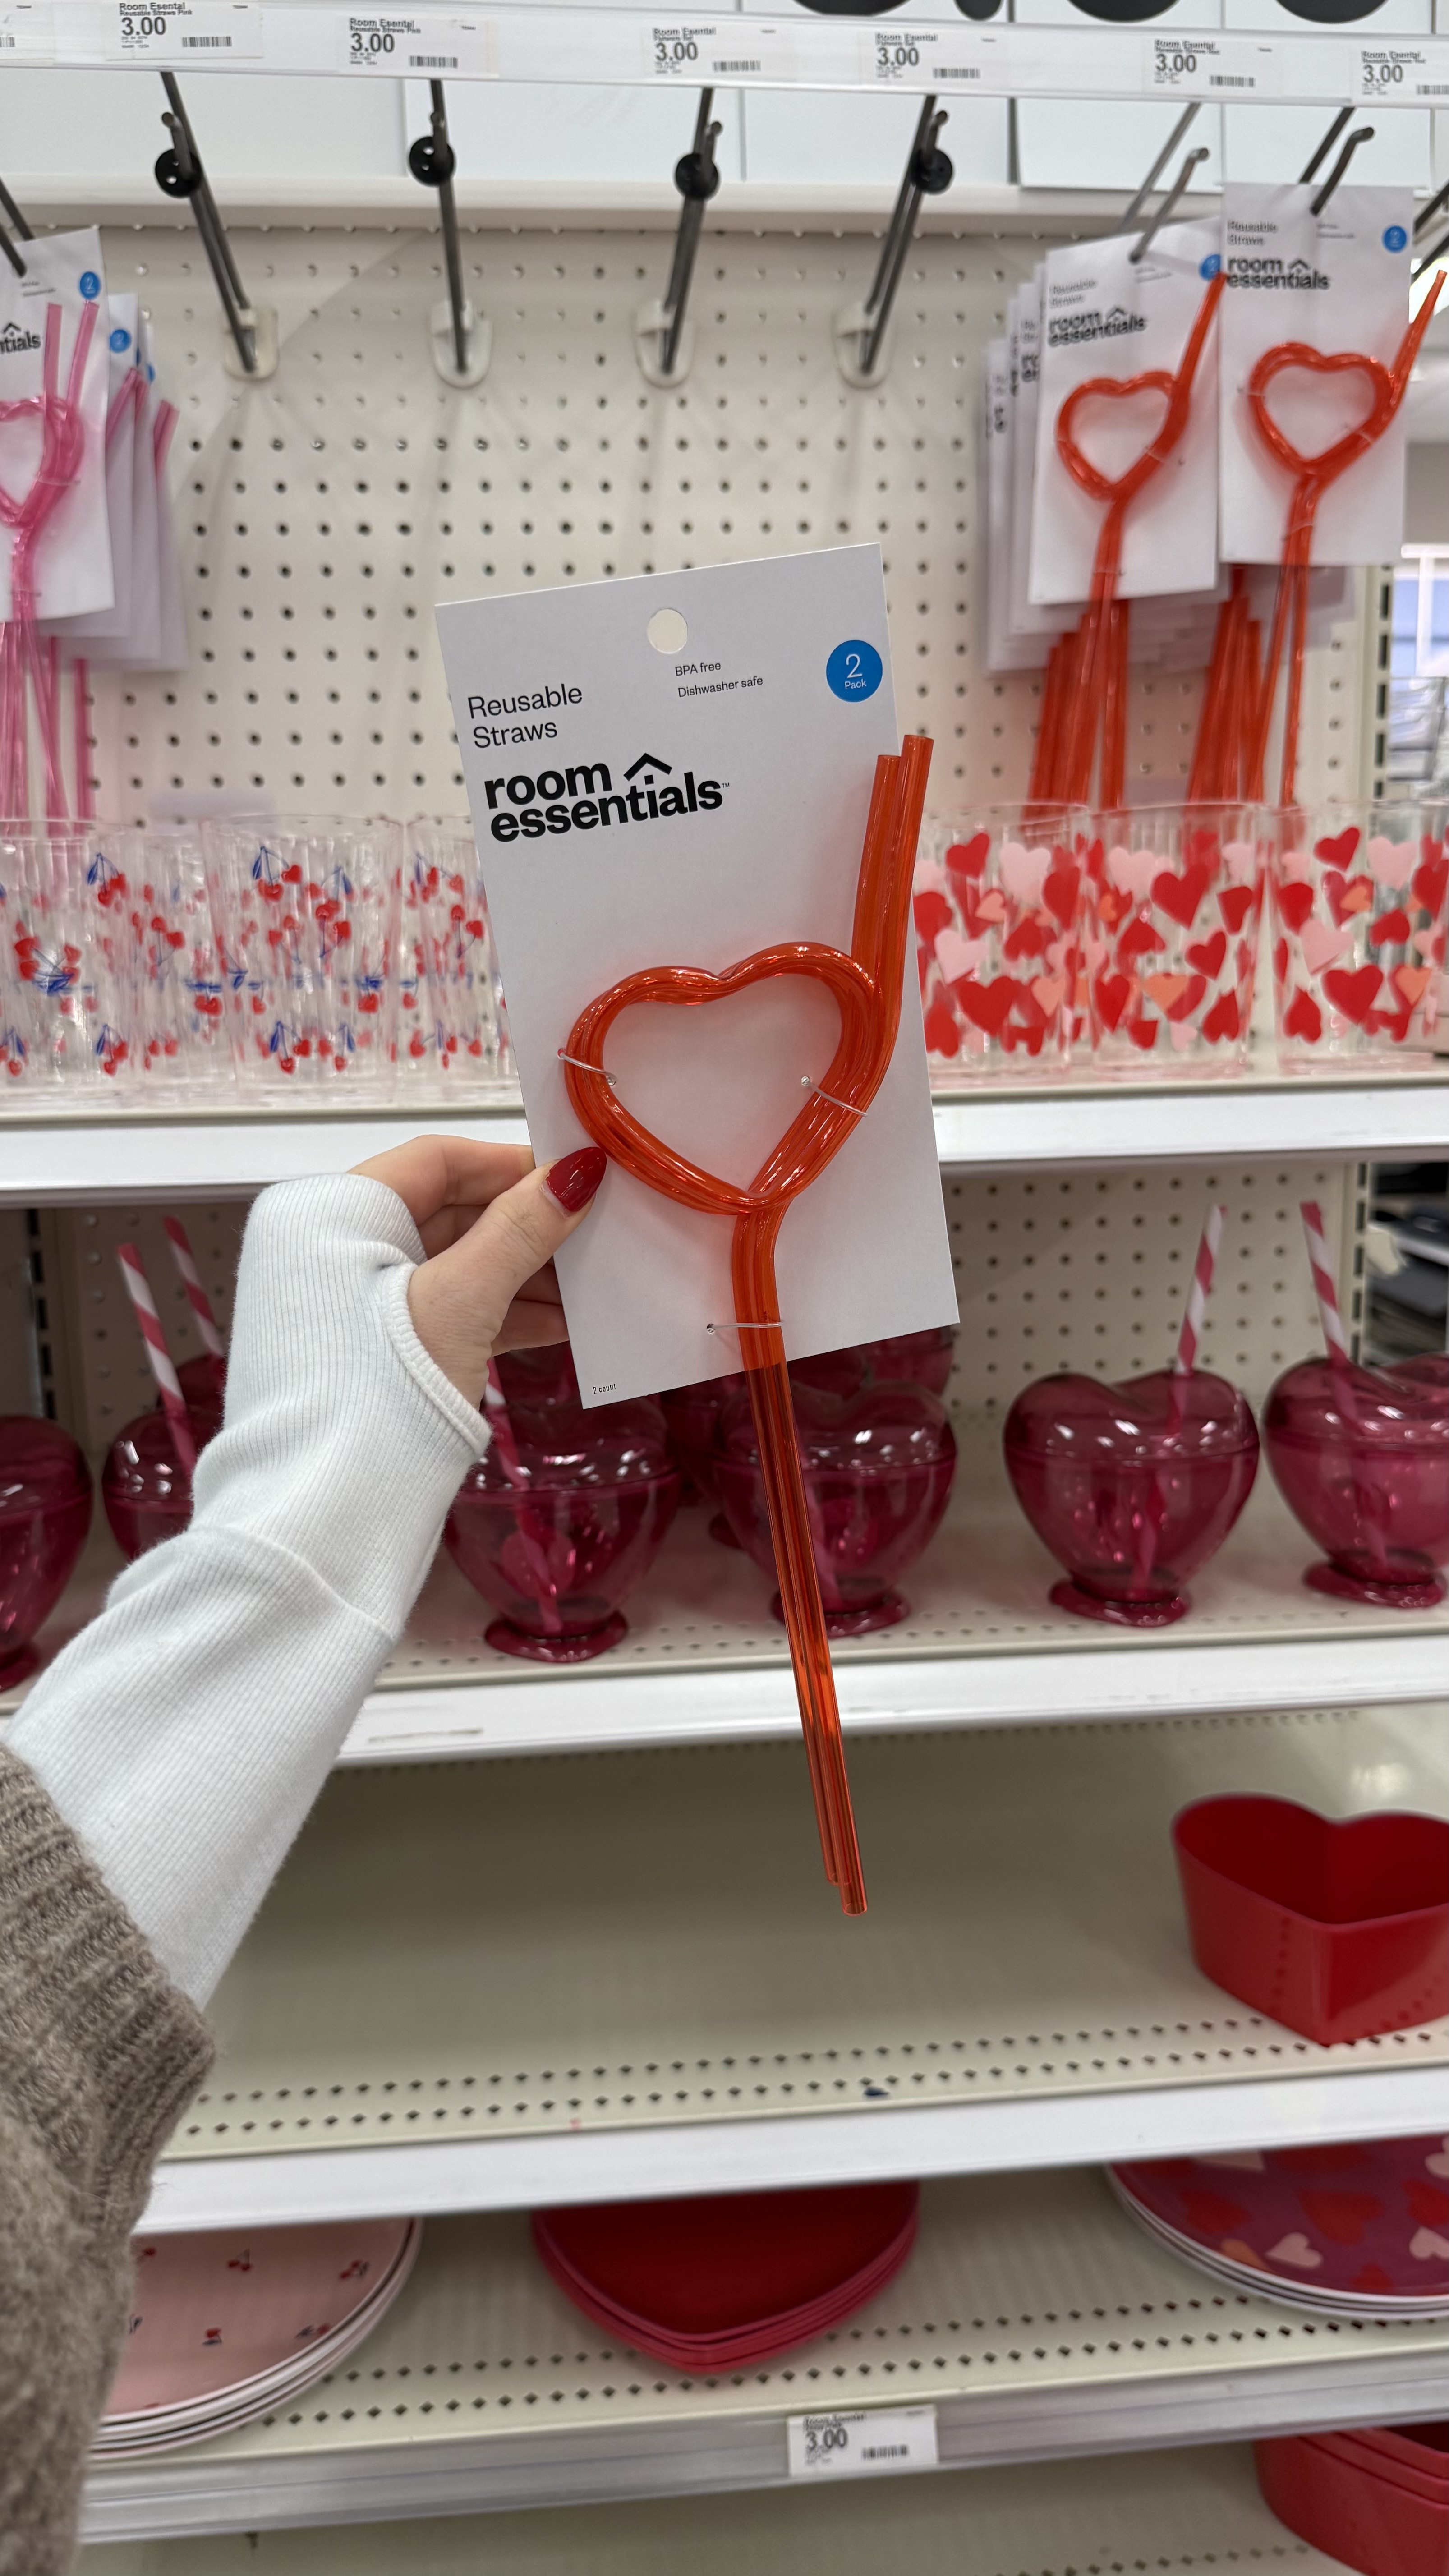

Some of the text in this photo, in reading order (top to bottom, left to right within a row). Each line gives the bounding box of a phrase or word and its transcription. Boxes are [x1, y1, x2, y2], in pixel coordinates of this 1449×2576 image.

[121, 17, 166, 35] 3.00
[350, 18, 377, 26] Room
[351, 33, 395, 52] 3.00
[656, 42, 698, 61] 3.00
[877, 47, 919, 66] 3.00
[1155, 53, 1197, 72] 3.00
[1362, 64, 1403, 83] 3.00
[1389, 229, 1400, 243] 2
[1228, 258, 1283, 272] room
[1226, 270, 1330, 290] essentials
[1048, 313, 1147, 346] essentials
[1049, 311, 1101, 333] room
[675, 662, 721, 676] BPA free
[846, 653, 863, 679] 2
[678, 676, 763, 697] Dishwasher safe
[845, 678, 866, 690] Pack
[468, 683, 582, 719] Reusable
[473, 722, 557, 748] Straws
[484, 763, 612, 809] room
[491, 772, 723, 842] essentials
[599, 1383, 616, 1393] count
